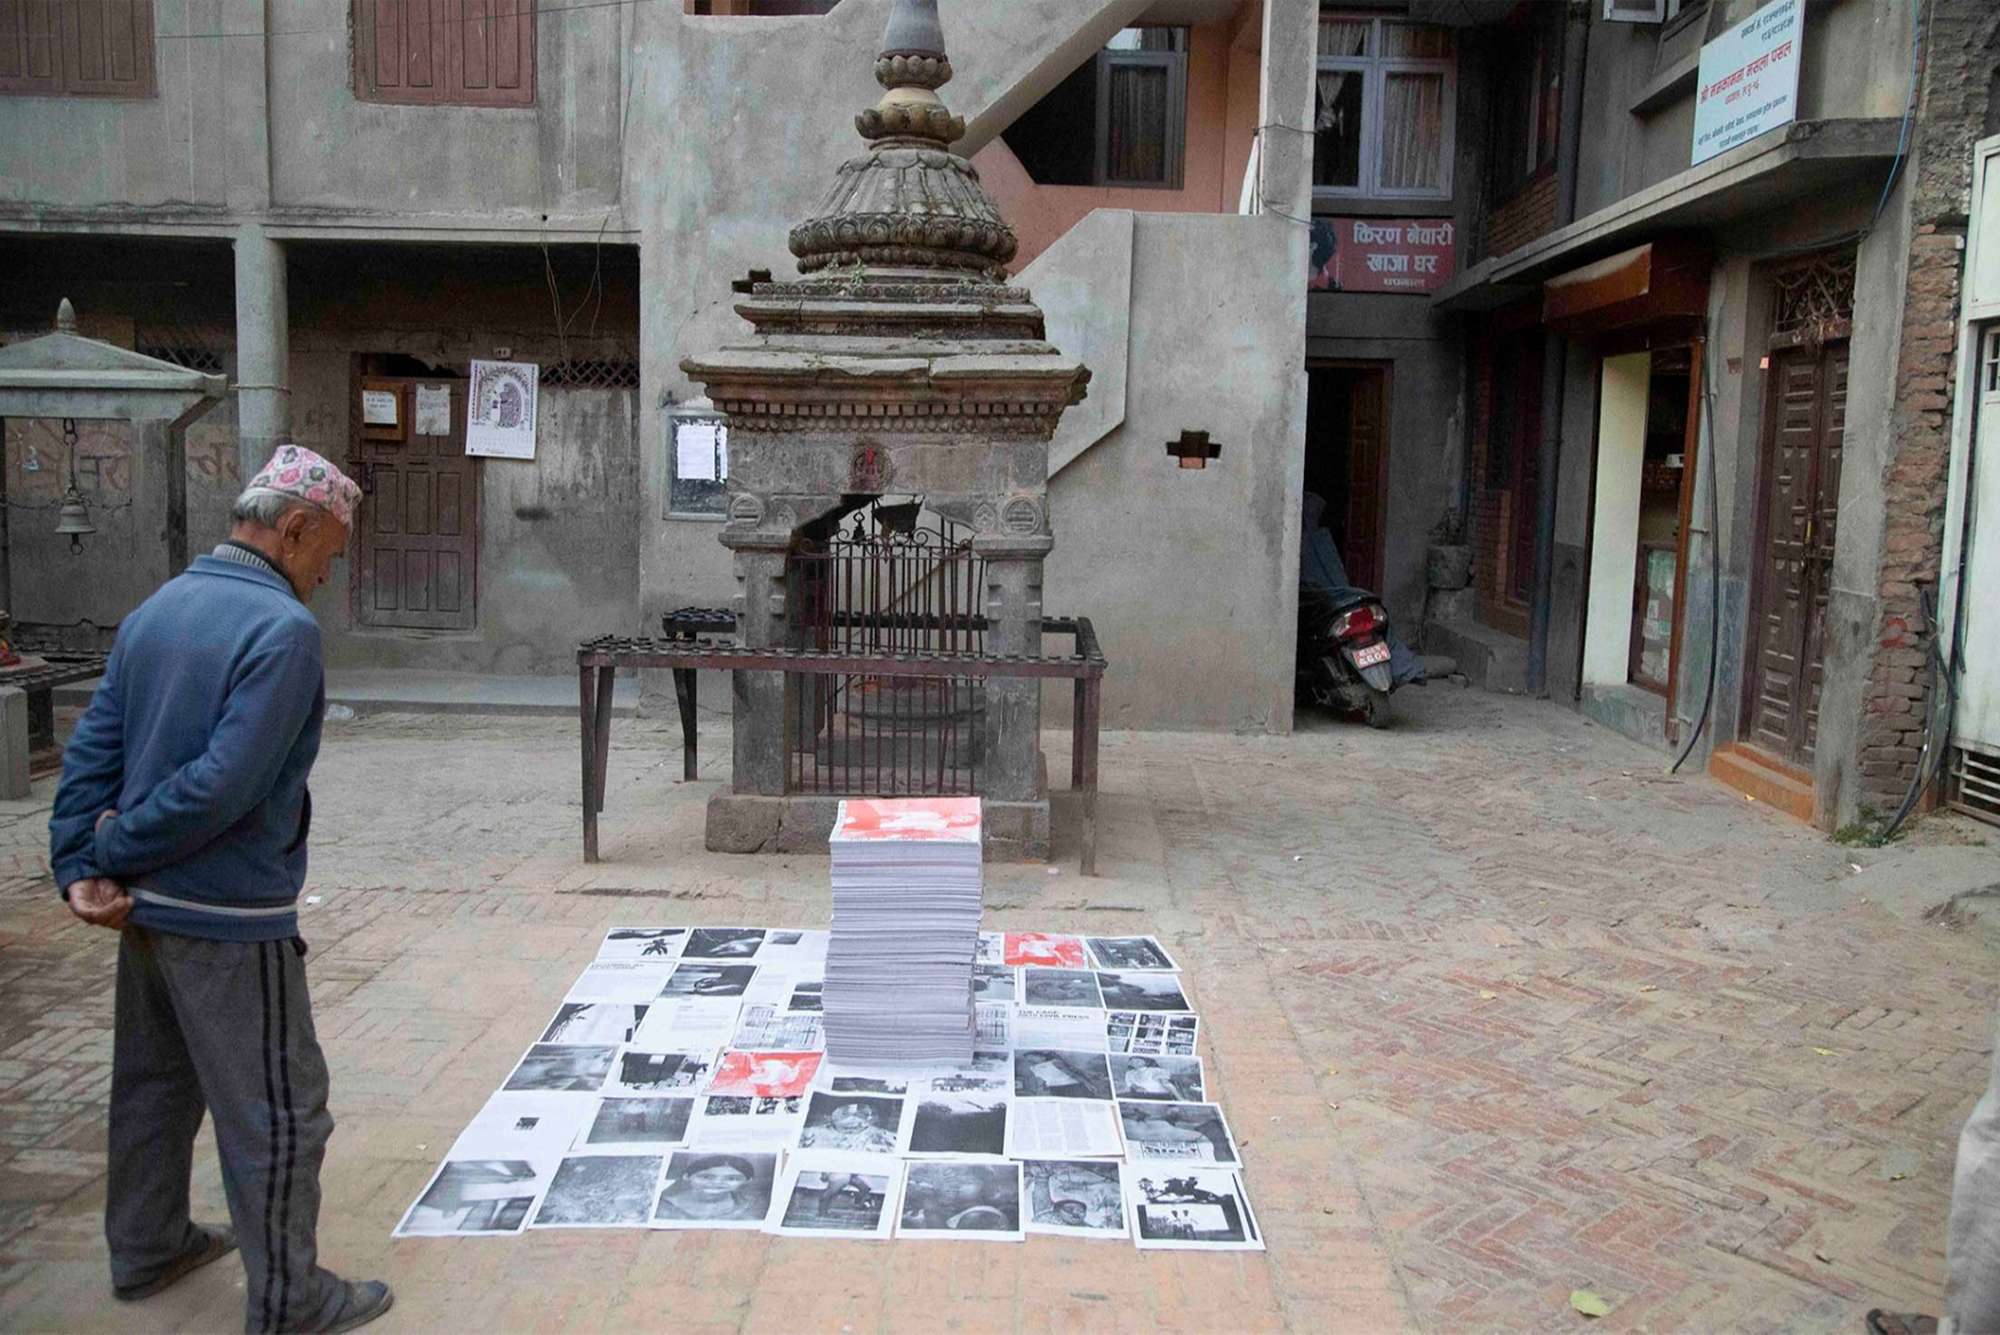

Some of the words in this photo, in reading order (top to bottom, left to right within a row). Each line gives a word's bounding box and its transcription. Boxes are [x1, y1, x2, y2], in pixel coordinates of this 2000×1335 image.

[1771, 40, 1793, 63] पसल
[1354, 221, 1402, 244] किरण
[1407, 222, 1454, 246] नेवारी
[1366, 254, 1409, 273] खाजा
[1414, 255, 1439, 273] घर
